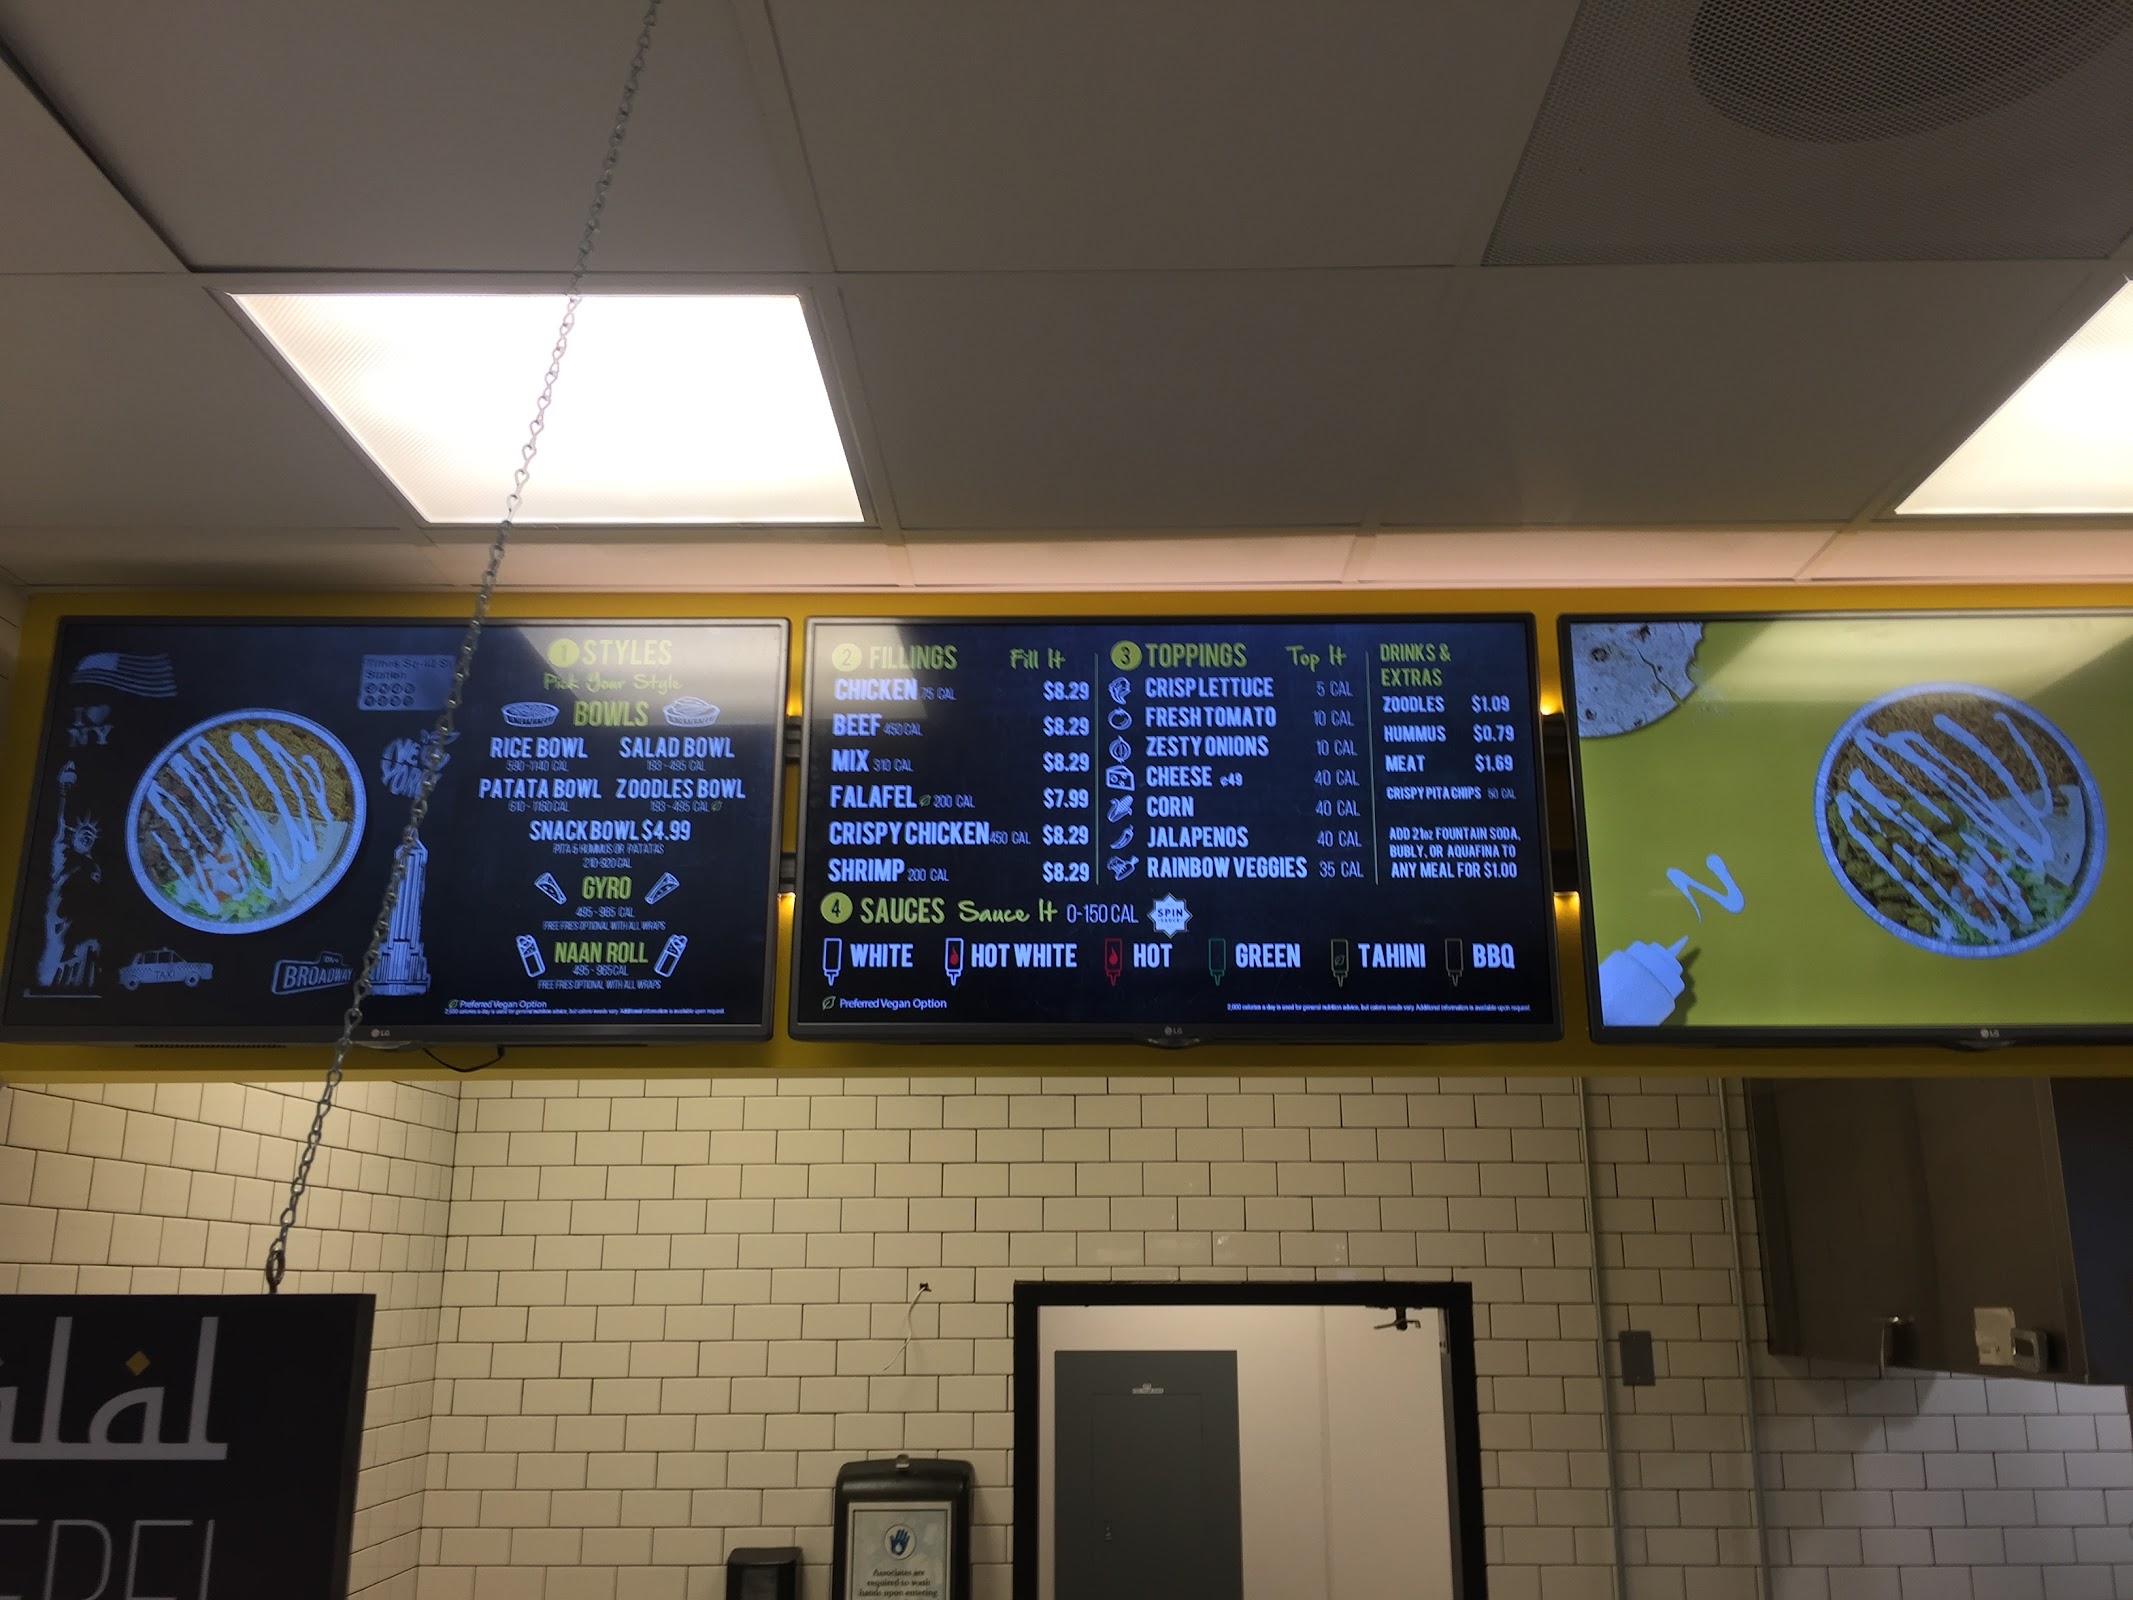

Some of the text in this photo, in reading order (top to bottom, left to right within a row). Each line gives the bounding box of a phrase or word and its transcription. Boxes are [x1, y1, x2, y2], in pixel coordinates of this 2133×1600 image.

[582, 639, 673, 666] STYLES
[869, 645, 959, 670] FILLINGS
[1009, 647, 1066, 670] Fill It
[1145, 642, 1248, 668] TOPPINGS
[1285, 644, 1347, 672] Top It
[1380, 643, 1451, 662] DRINKS &
[543, 673, 683, 696] Pick Your Style
[1145, 676, 1275, 699] CRISP LETTUCE
[1381, 668, 1443, 687] EXTRAS
[834, 678, 918, 701] CHICKEN
[937, 687, 957, 700] CAL
[1043, 680, 1090, 702] $8.29
[1316, 681, 1354, 697] 5 CAL
[574, 701, 649, 727] BOWLS
[1382, 694, 1510, 714] ZOODLES $1.09
[832, 713, 882, 737] BEEF
[902, 723, 924, 736] CAL
[1043, 715, 1090, 737] $8.29
[1145, 706, 1277, 728] FRESH TOMATO
[1312, 710, 1355, 727] 10 CAL
[1384, 723, 1515, 744] HUMMUS $0.79
[490, 737, 588, 758] RICE BOWL
[619, 736, 735, 758] SALAD BOWL
[1145, 735, 1270, 758] ZESTY ONIONS
[1315, 739, 1358, 756] 10 CAL
[831, 749, 871, 772] MIX
[894, 758, 914, 773] CAL
[1043, 751, 1090, 773] $8.29
[1385, 753, 1514, 774] MEAT $1.69
[1146, 765, 1213, 788] CHEESE
[1314, 769, 1360, 787] 40 CAL
[479, 778, 602, 799] PATATA BOWL
[615, 778, 746, 799] ZOODLES BOWL
[830, 785, 976, 809] FALAFEL 200 CAL
[1043, 787, 1089, 810] $7.99
[1386, 786, 1425, 800] CRISPY
[1425, 786, 1450, 800] PITA
[1450, 786, 1482, 800] CHIPS
[1147, 795, 1194, 818] CORN
[1315, 799, 1361, 816] 40 CAL
[529, 819, 691, 842] SNACK BOWL $4.99
[829, 821, 902, 845] CRISPY
[905, 821, 990, 845] CHICKEN
[1011, 831, 1031, 845] CAL
[1042, 824, 1089, 846] $8.29
[1147, 826, 1249, 848] JALAPENOS
[1316, 830, 1362, 847] 40 CAL
[1389, 827, 1411, 841] ADD
[1435, 827, 1487, 841] FOUNTAIN
[1489, 827, 1521, 841] SODA,
[1389, 844, 1516, 859] BUBLY, OR AQUAFINA TO
[828, 857, 950, 883] SHRIMP 200 CAL
[1042, 861, 1090, 884] $8.29
[1147, 856, 1308, 878] RAINBOW VEGGIES
[1319, 861, 1364, 878] 35 CAL
[1391, 861, 1518, 879] ANY MEAL FOR $1.00
[582, 876, 632, 900] GYRO
[860, 897, 945, 925] SAUCES
[959, 898, 1139, 924] Sauce It 0-150 CAL
[1158, 908, 1183, 918] SPIN
[554, 942, 649, 963] NAAN ROLL
[850, 943, 914, 968] WHITE
[971, 943, 1078, 968] HOT WHITE
[1133, 943, 1173, 968] HOT
[1235, 943, 1301, 969] GREEN
[1358, 943, 1426, 968] TAHINI
[1473, 943, 1515, 970] BBQ
[154, 970, 175, 980] TAXI
[283, 965, 354, 989] BROADWAY
[494, 1000, 518, 1010] Vegan
[519, 1000, 547, 1010] Option
[839, 998, 947, 1012] Preferred Vegan Option
